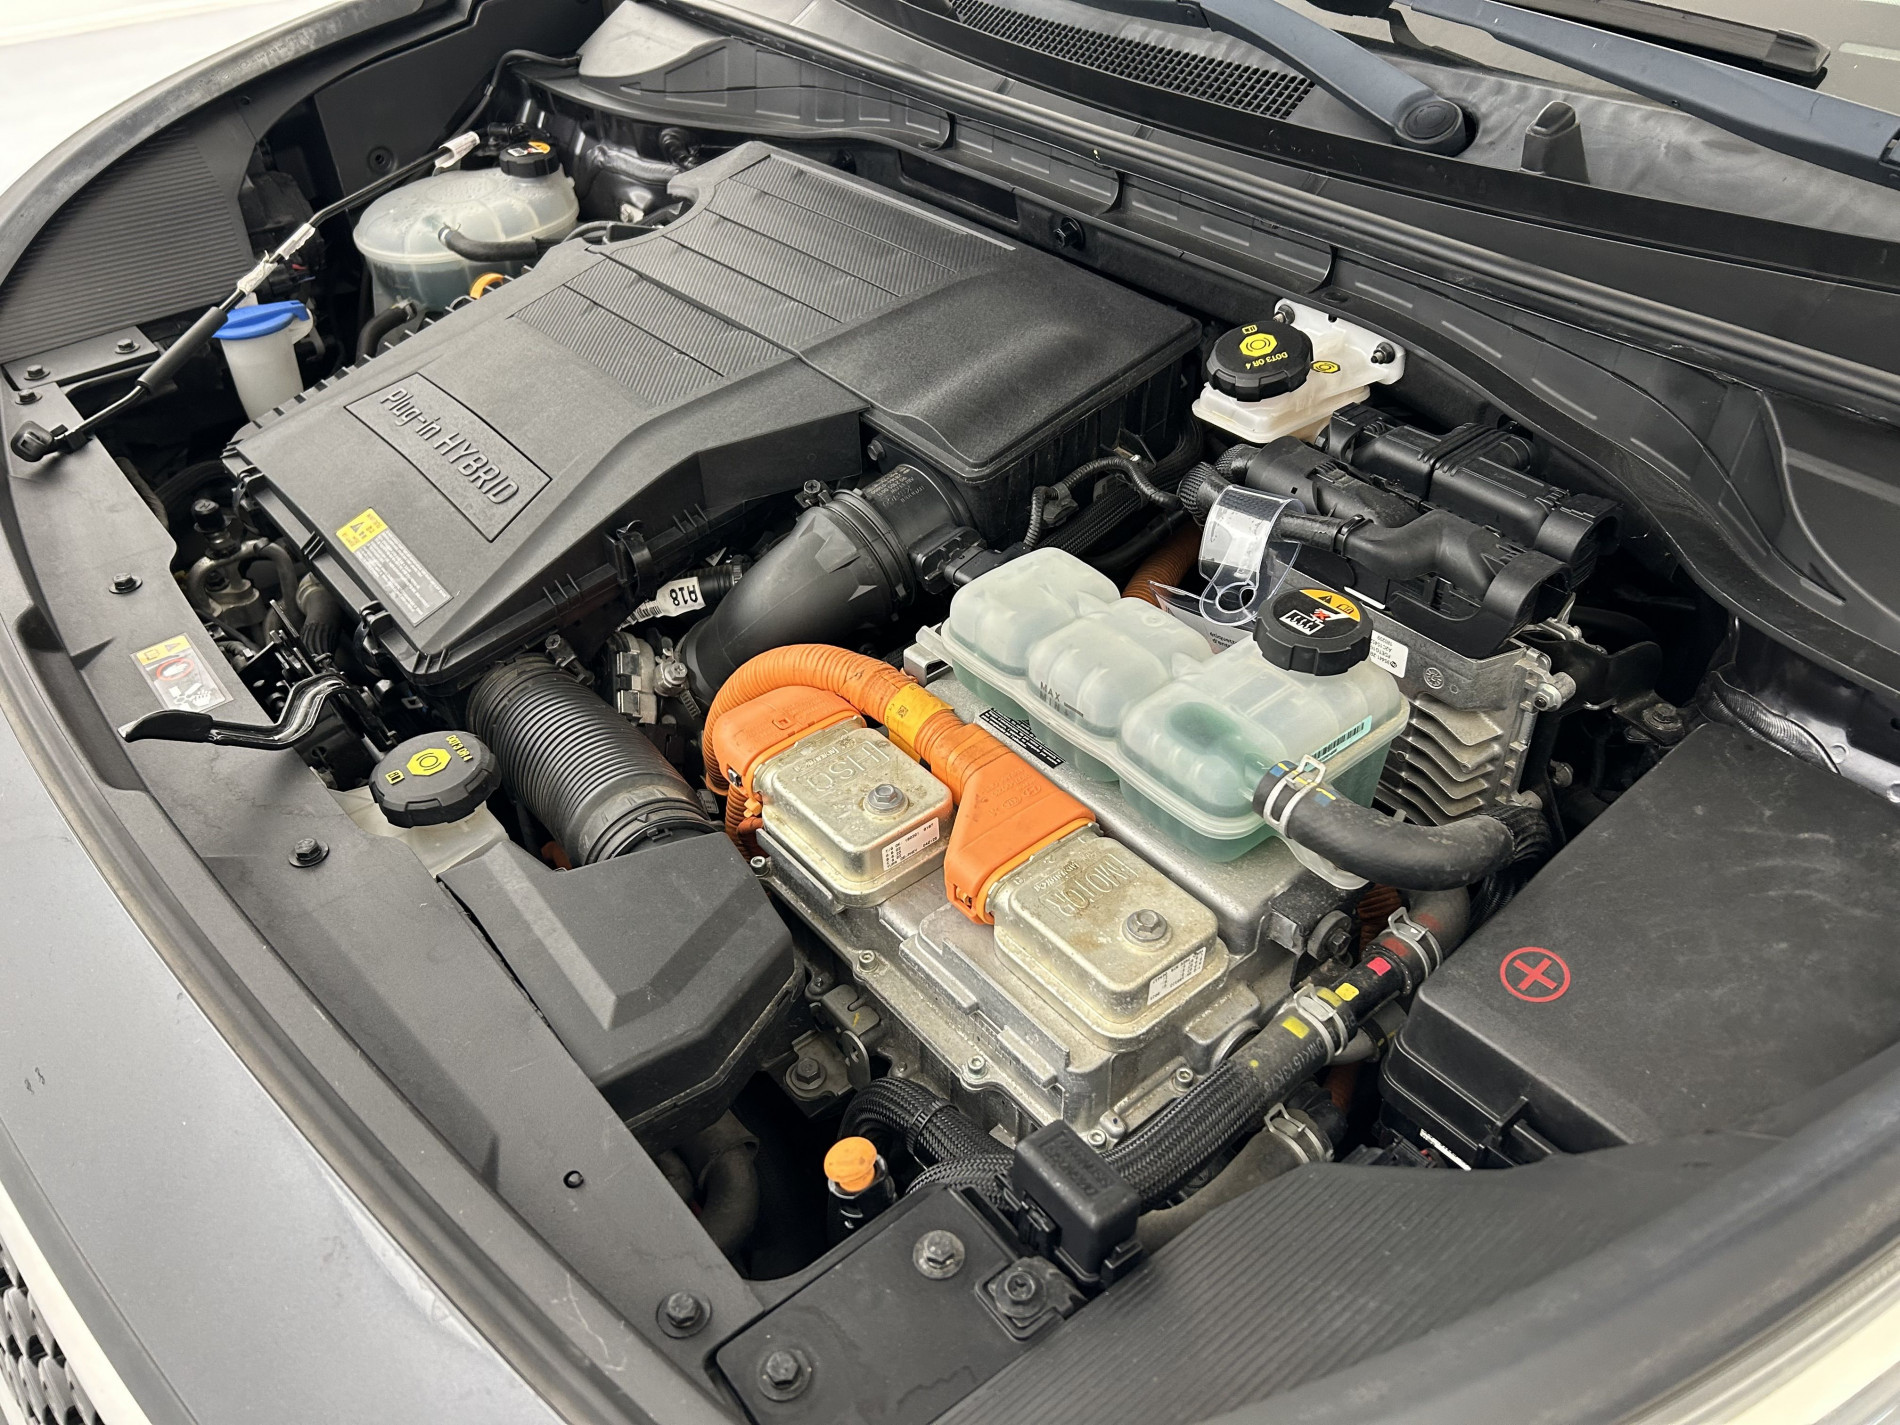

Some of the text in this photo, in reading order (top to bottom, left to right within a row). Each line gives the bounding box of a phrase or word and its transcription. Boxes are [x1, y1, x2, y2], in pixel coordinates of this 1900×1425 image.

[1245, 351, 1288, 370] DOT3 OR 4
[380, 387, 519, 504] Plug-in HYBRID
[668, 584, 699, 607] A18
[1039, 690, 1060, 712] MIN
[1040, 680, 1060, 702] MAX
[1046, 859, 1128, 917] MOTOR
